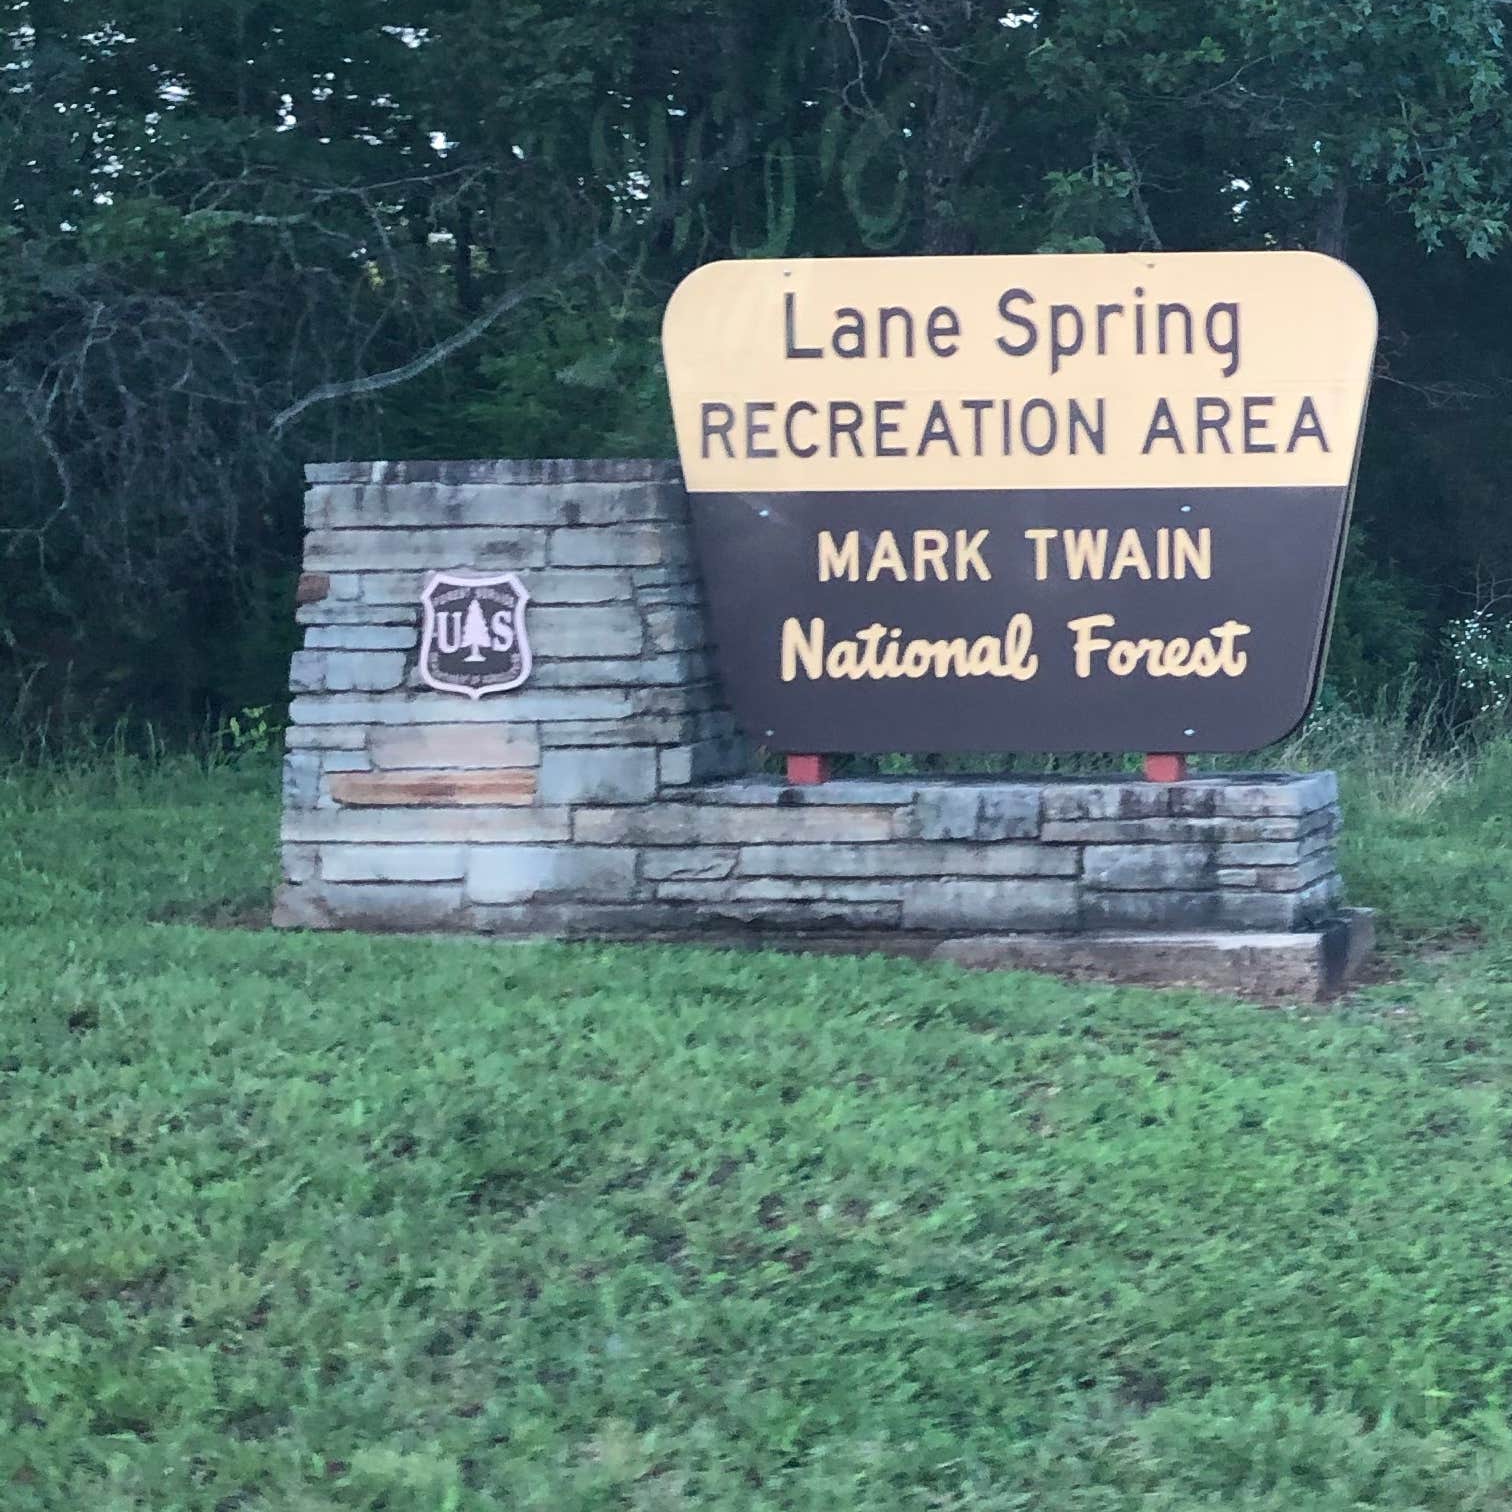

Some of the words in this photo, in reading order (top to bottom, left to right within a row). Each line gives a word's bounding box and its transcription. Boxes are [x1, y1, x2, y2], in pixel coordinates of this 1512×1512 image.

[784, 293, 961, 360] Lane
[995, 287, 1243, 377] Spring
[700, 396, 1107, 460] RECREATION
[1140, 395, 1333, 456] AREA
[817, 528, 993, 583] MARK
[1023, 526, 1213, 581] TWAIN
[779, 611, 1039, 683] National
[1066, 613, 1252, 679] Forest
